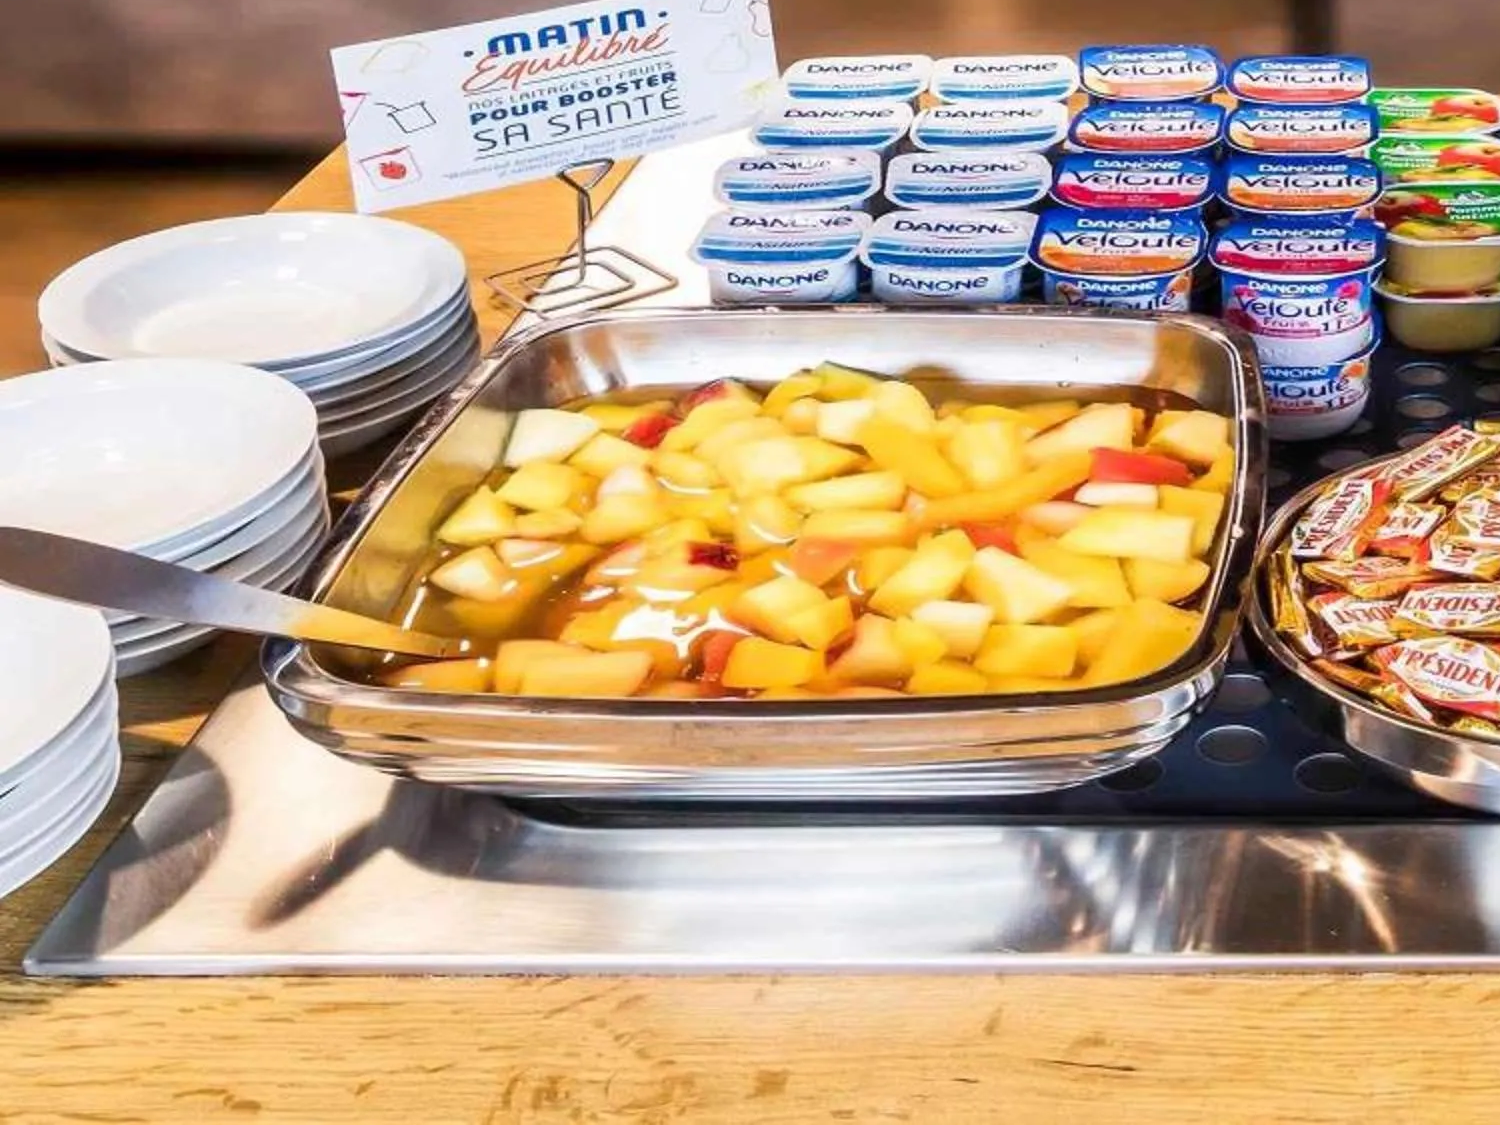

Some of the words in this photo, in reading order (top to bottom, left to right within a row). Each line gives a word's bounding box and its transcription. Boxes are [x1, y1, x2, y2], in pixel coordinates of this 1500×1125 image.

[487, 8, 647, 57] MATIN
[618, 60, 673, 82] FRUITS
[807, 61, 914, 75] DANONE
[953, 61, 1060, 75] DANONE
[470, 100, 550, 126] POUR
[559, 70, 678, 108] BOOSTER
[472, 122, 530, 153] SA
[547, 84, 682, 138] SANTÉ
[784, 108, 895, 119] DANONE
[1093, 159, 1183, 171] DANONE
[1257, 163, 1349, 173] DANONE
[1076, 218, 1172, 229] DANONE
[1251, 227, 1347, 238] DANONE
[727, 268, 829, 288] DANONE
[888, 271, 989, 293] DANONE
[1077, 279, 1160, 293] DANONE
[1248, 279, 1330, 294] DANONE
[1262, 365, 1330, 378] ANONE
[1265, 376, 1350, 399] elouté
